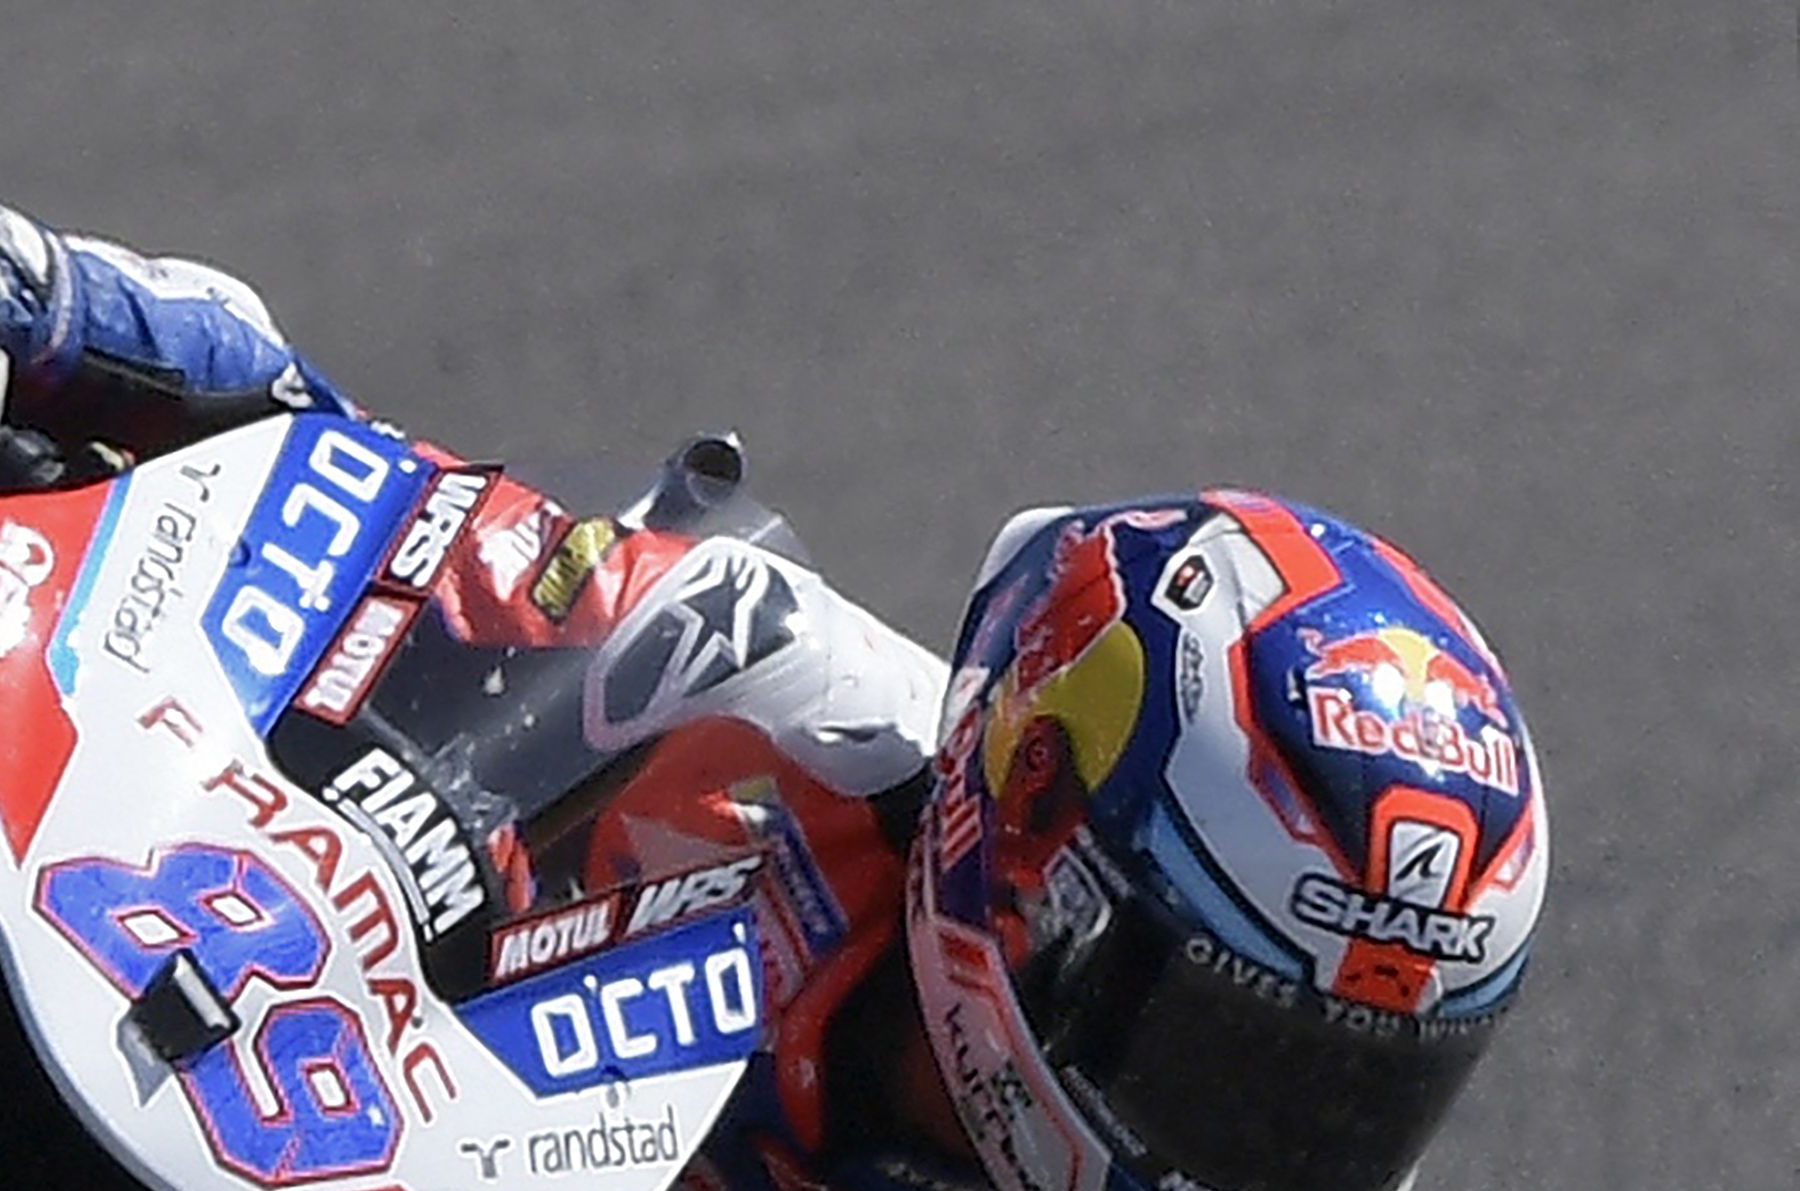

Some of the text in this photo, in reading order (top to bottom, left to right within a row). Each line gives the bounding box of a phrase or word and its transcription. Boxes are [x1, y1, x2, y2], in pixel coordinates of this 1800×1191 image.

[102, 503, 197, 674] randstad
[1307, 686, 1518, 797] Red Bull
[333, 748, 485, 934] FIAMM
[495, 903, 611, 979] MOTUL
[1294, 875, 1495, 961] SHARK
[33, 842, 404, 1187] 89
[529, 1103, 678, 1174] randstad
